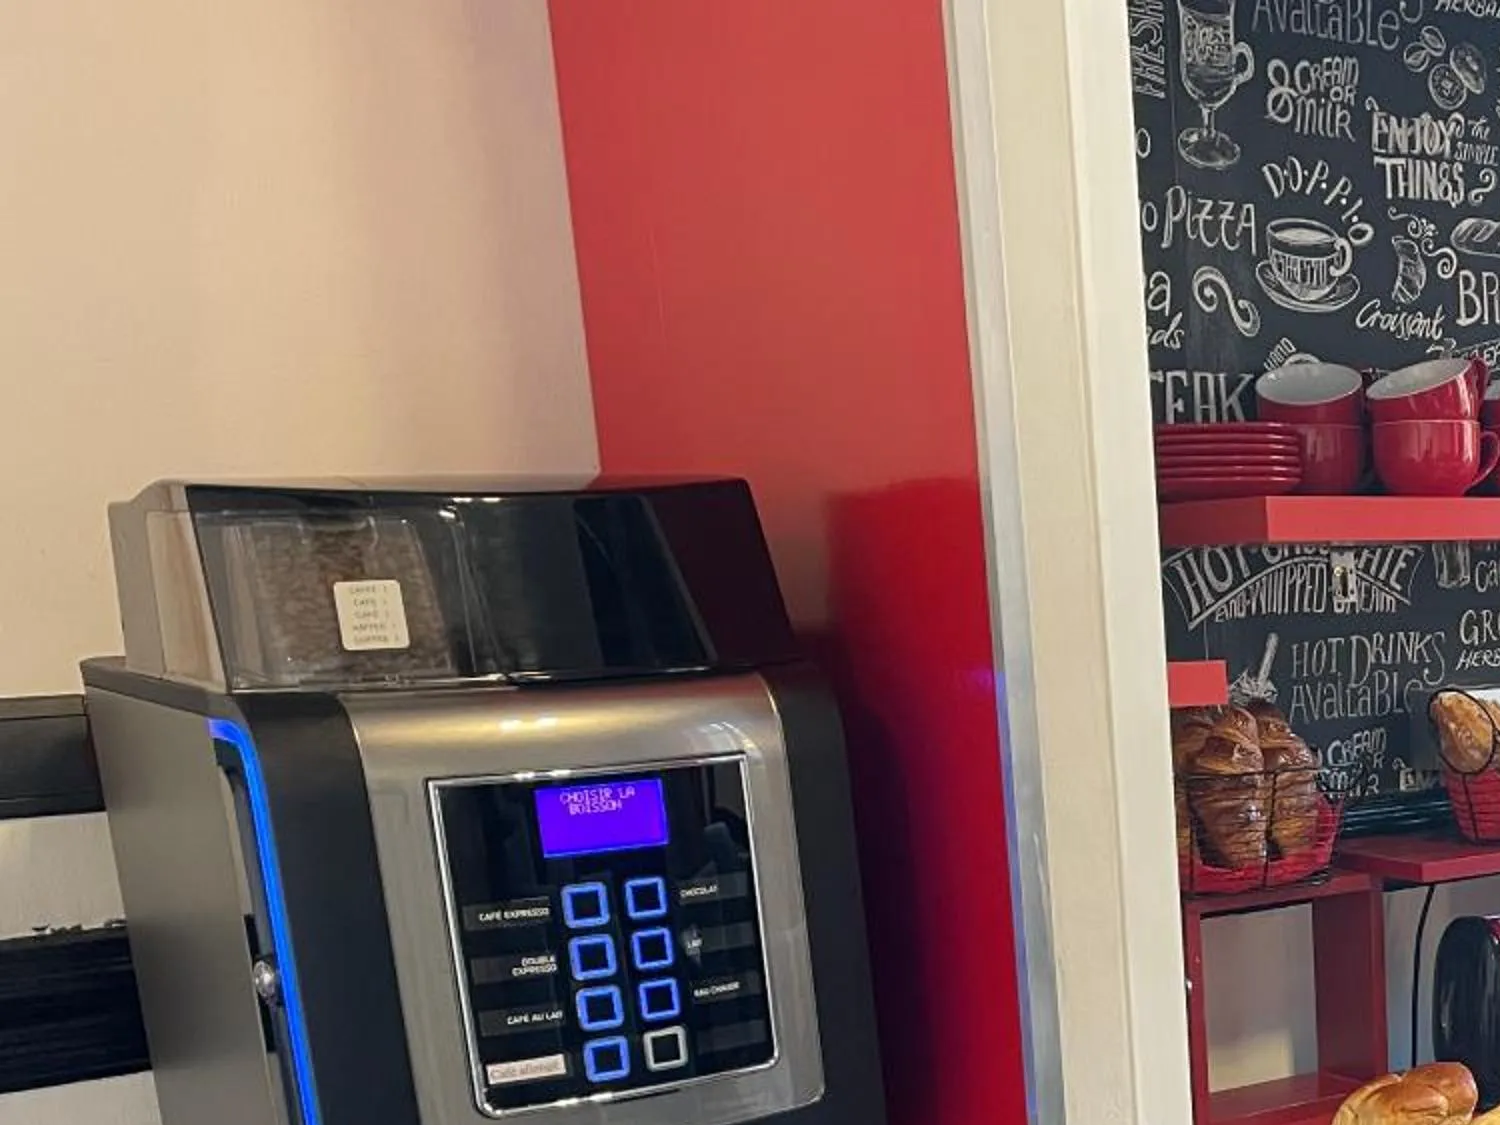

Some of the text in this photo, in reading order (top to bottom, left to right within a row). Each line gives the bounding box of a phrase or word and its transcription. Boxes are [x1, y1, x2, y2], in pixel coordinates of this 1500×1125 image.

[1293, 56, 1360, 96] CREAM
[1370, 109, 1465, 159] ENJOY
[1373, 155, 1465, 208] THINGS
[1355, 298, 1445, 341] Croissant
[1291, 630, 1447, 689] HOT DRINKS
[559, 785, 636, 806] CHOISIR LA
[568, 799, 623, 816] BOISSON
